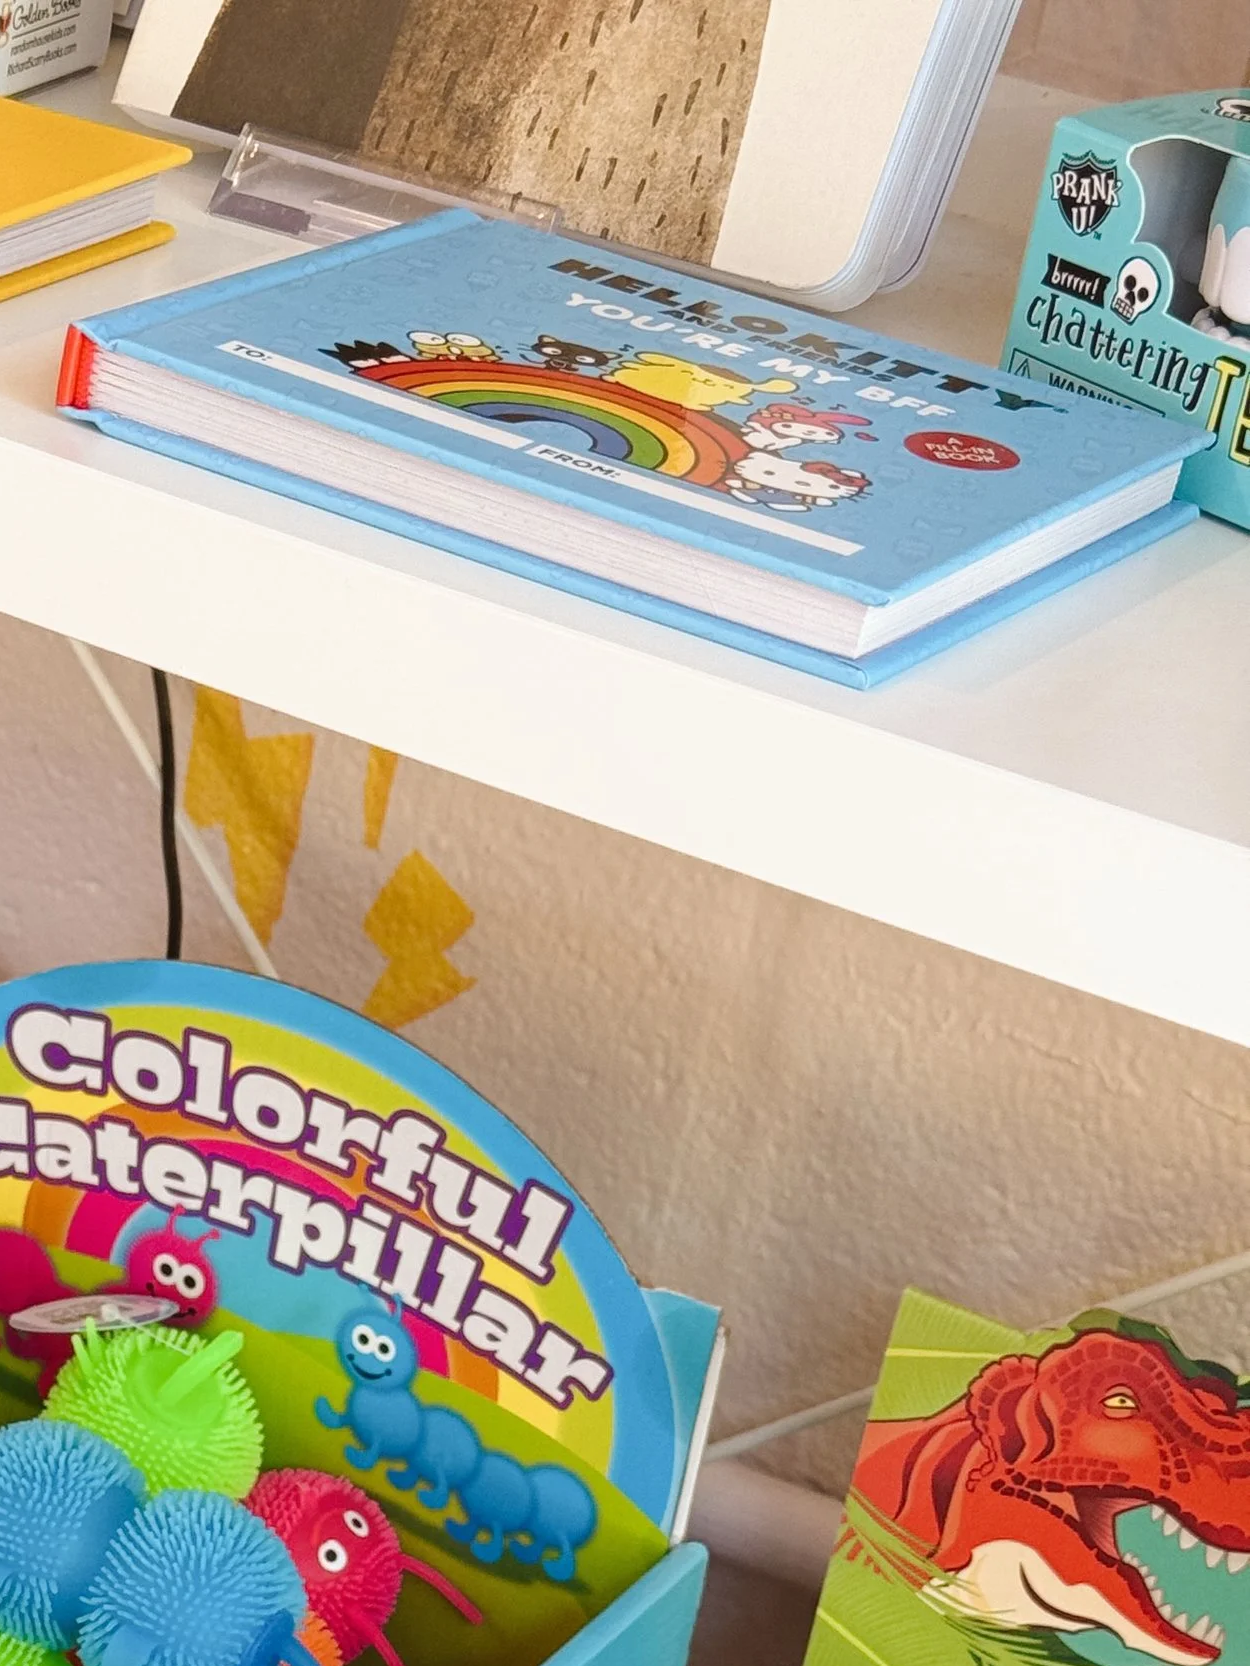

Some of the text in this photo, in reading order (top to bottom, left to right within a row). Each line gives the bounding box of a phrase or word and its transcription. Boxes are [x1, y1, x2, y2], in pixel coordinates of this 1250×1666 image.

[1050, 171, 1124, 208] PRANK
[1071, 205, 1097, 234] U!
[234, 344, 274, 364] TO:
[547, 258, 788, 336] HELLO
[788, 333, 1056, 411] KITTY
[565, 292, 956, 417] YOU'RE MY BFF
[657, 309, 898, 383] AND FRIENDS
[1025, 293, 1216, 414] chattering
[538, 448, 622, 480] FROM:
[934, 451, 1000, 464] BOOK
[6, 1002, 574, 1284] Colorful
